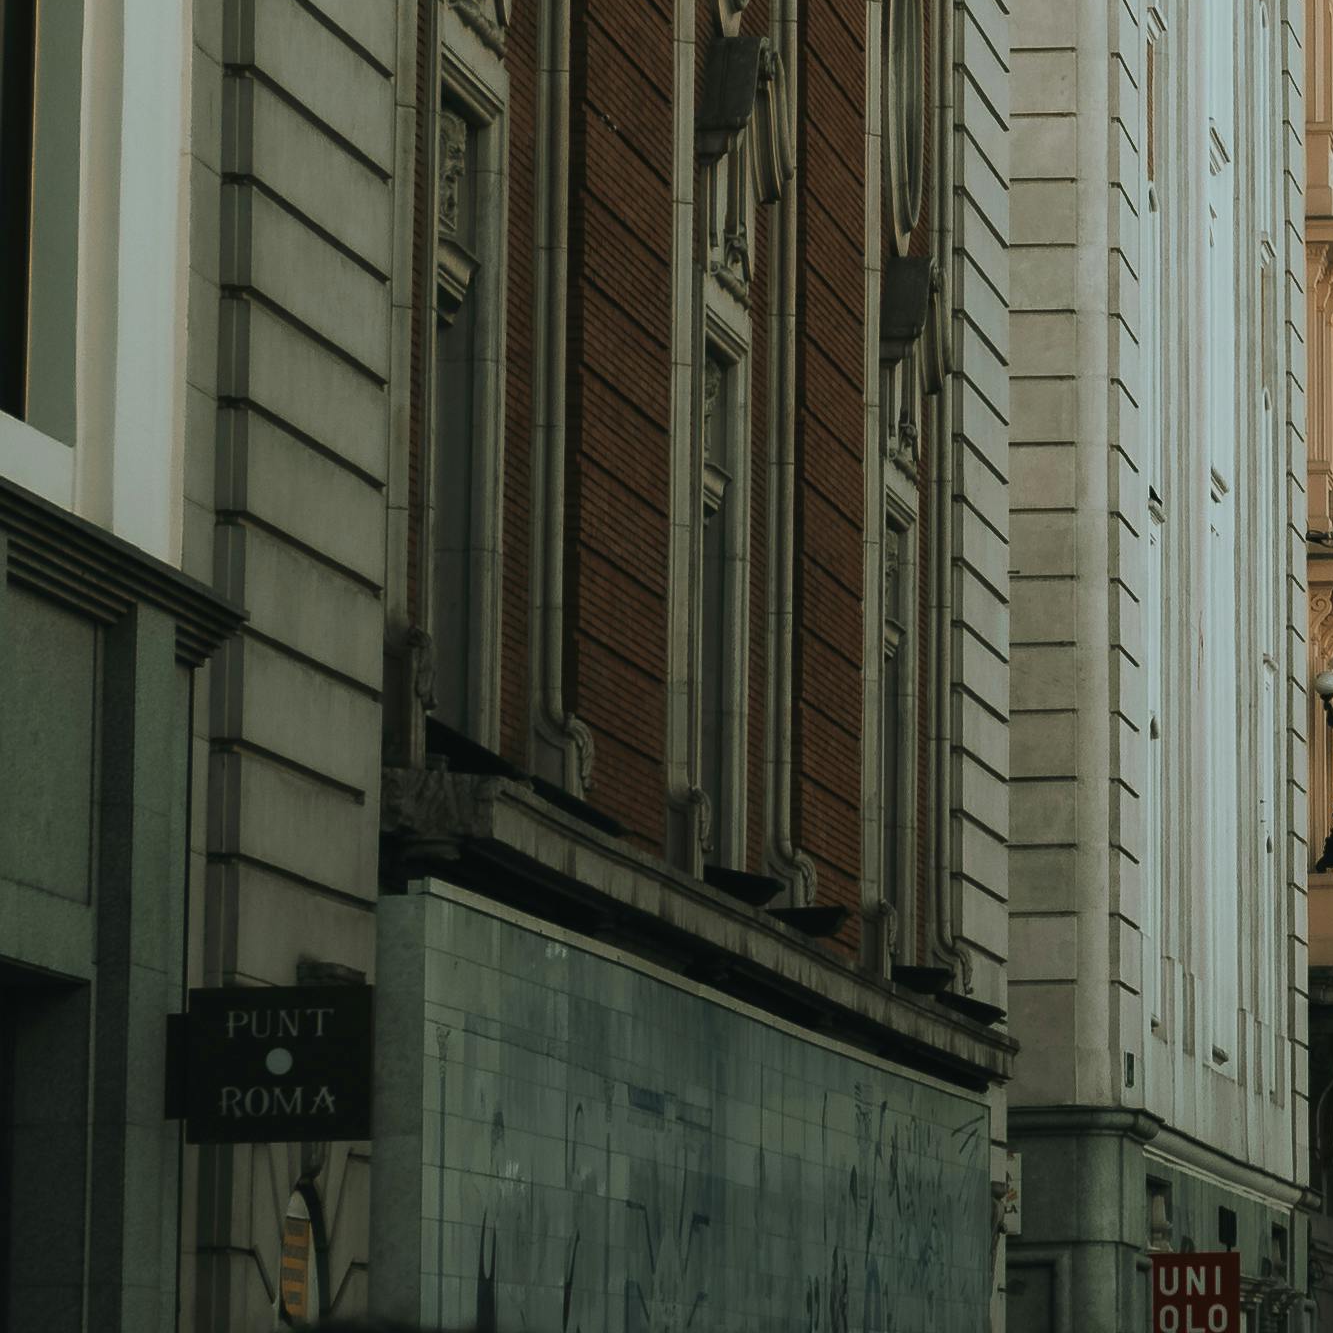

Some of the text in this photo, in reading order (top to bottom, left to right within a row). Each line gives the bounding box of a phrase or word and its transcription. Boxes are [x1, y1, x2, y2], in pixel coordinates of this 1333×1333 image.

[225, 1008, 334, 1039] PUNT
[219, 1085, 337, 1117] ROMA
[1159, 1264, 1222, 1296] UNI
